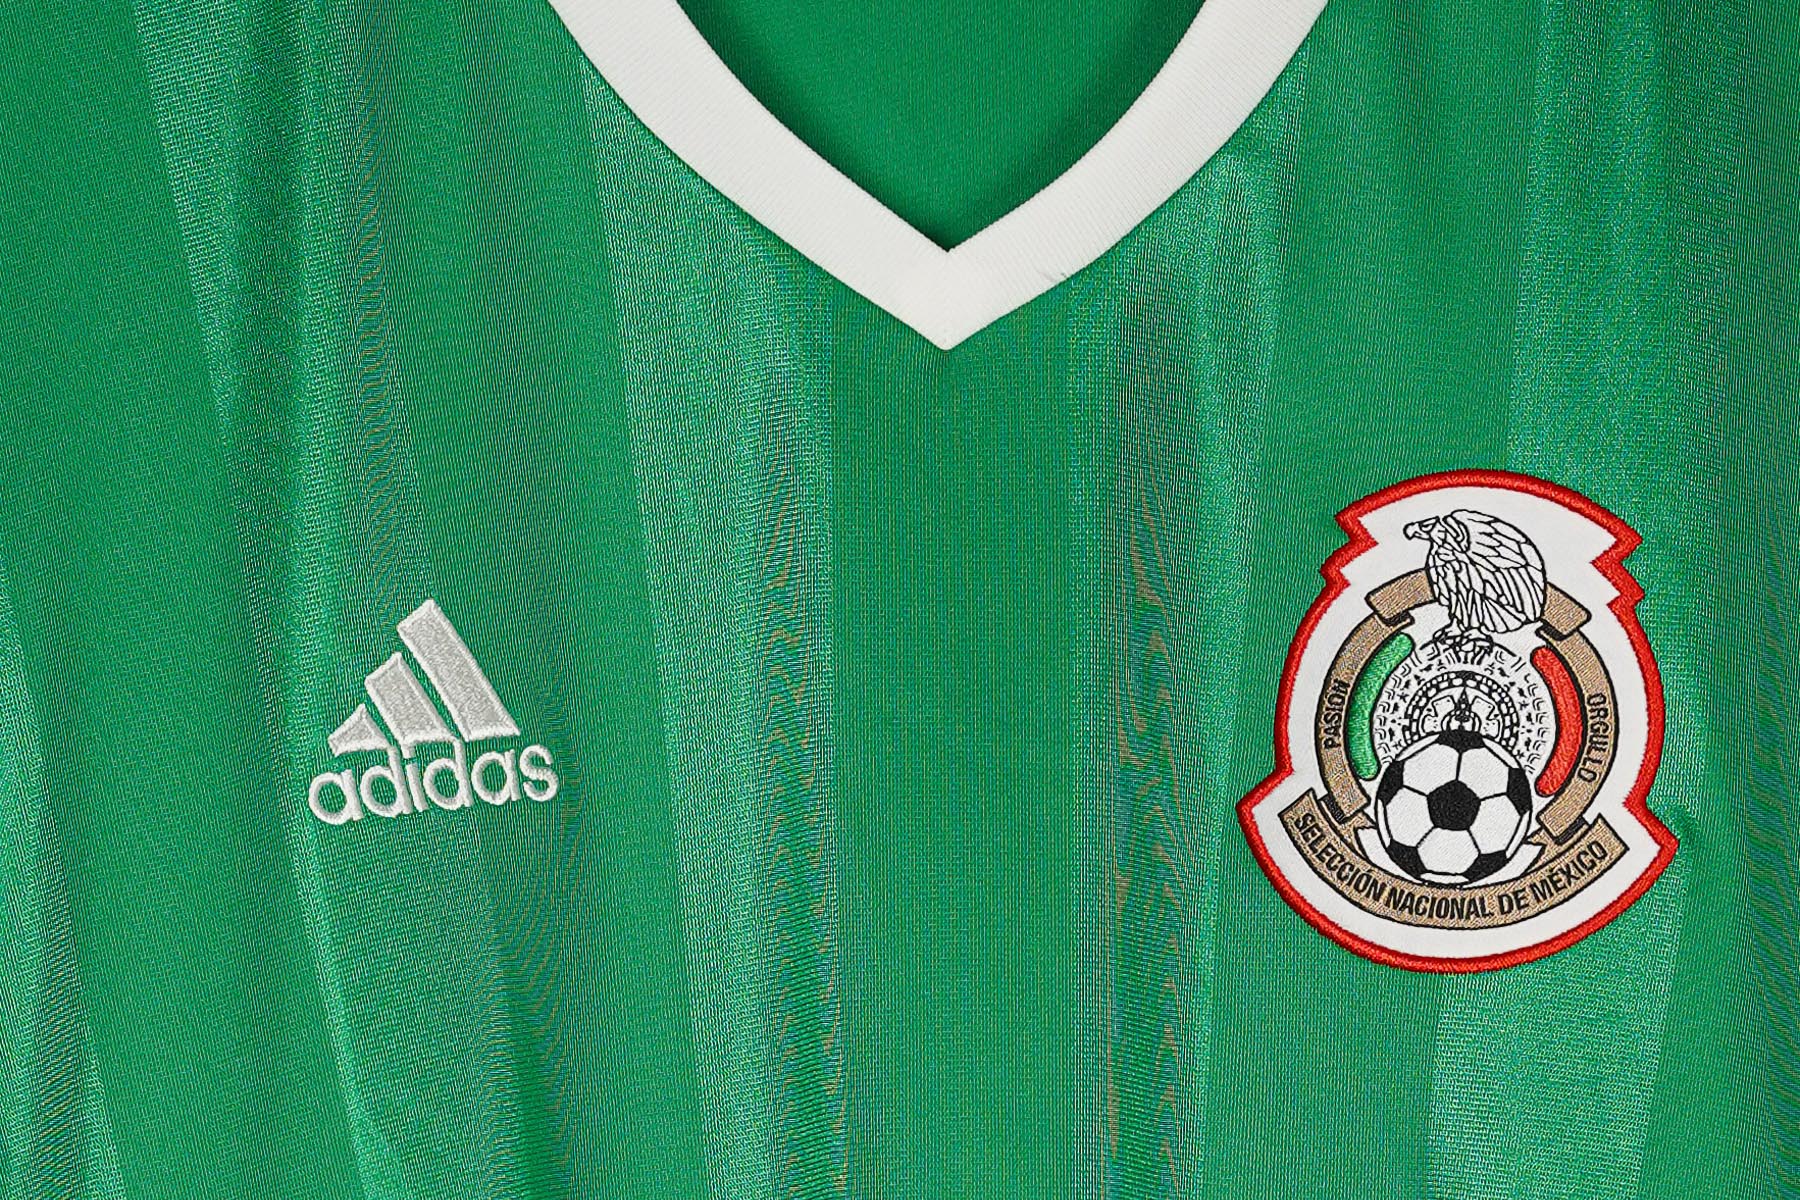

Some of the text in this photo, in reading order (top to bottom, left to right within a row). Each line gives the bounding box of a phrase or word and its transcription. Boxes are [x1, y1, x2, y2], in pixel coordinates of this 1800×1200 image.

[308, 738, 559, 825] adidas
[1578, 693, 1609, 783] ORGULLO
[1295, 813, 1387, 902] SELECCIÓN
[1384, 887, 1494, 920] NACIONAL
[1498, 889, 1530, 915] DE
